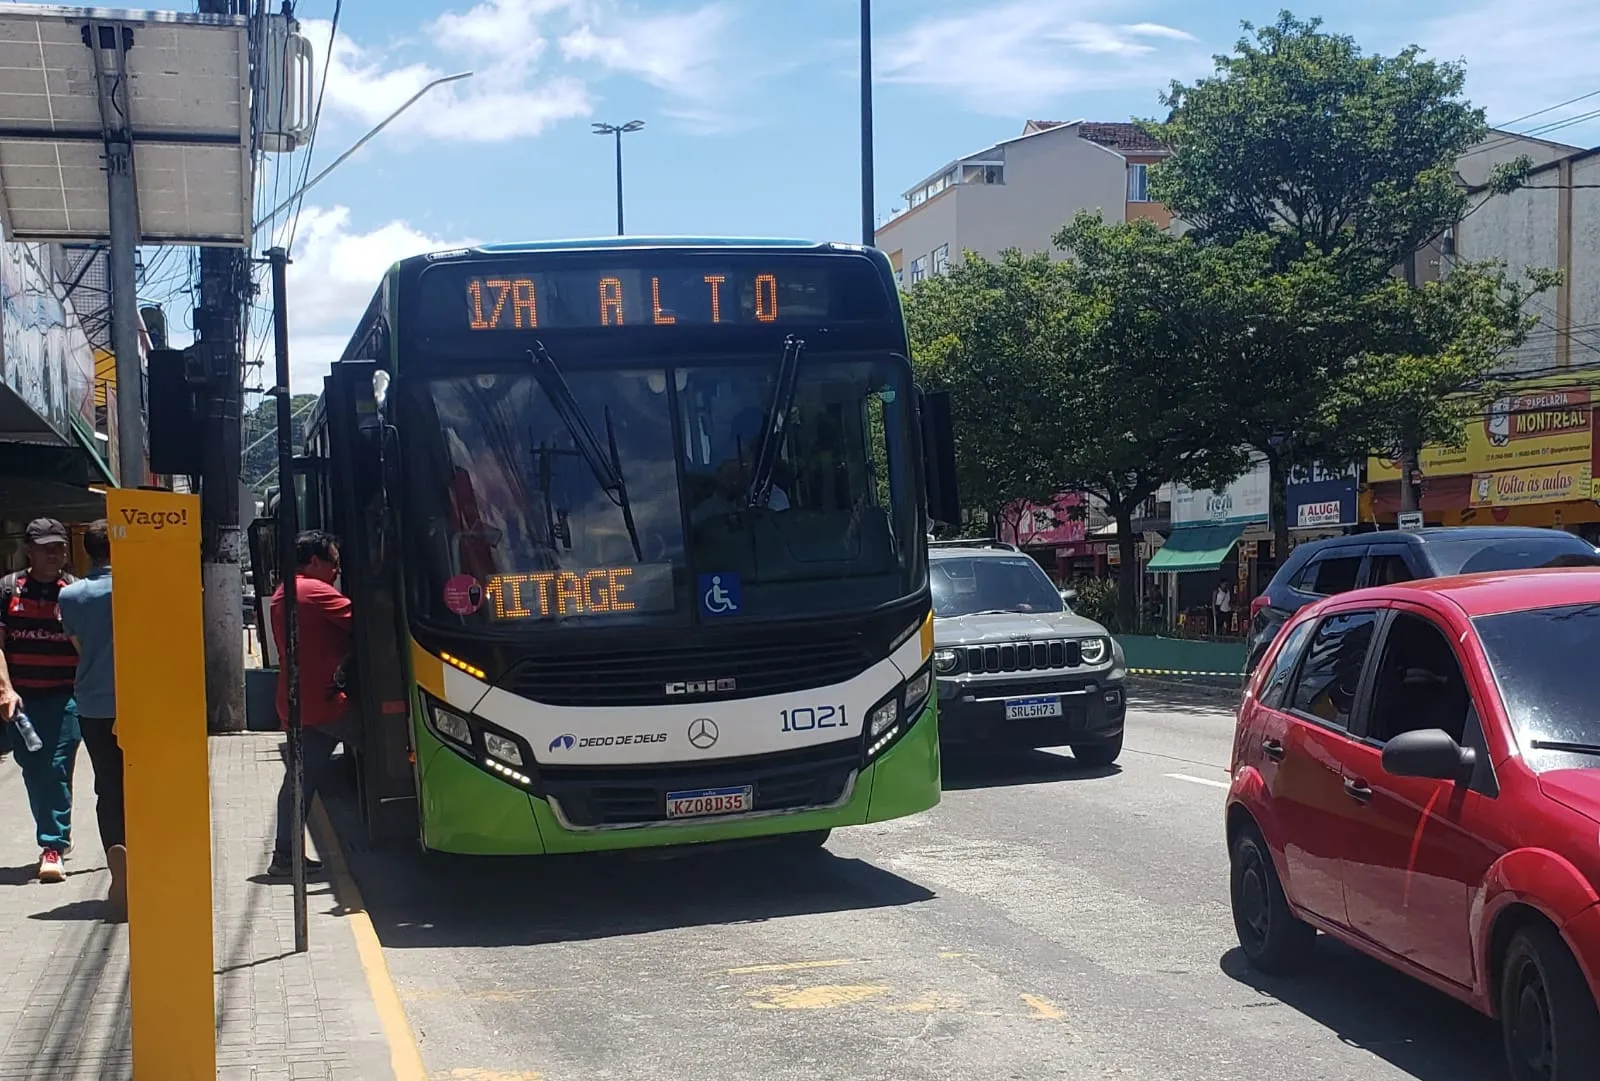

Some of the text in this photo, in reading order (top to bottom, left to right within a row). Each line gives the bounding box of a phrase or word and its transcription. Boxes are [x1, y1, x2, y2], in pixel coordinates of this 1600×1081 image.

[469, 274, 777, 329] 17A ALTO
[1526, 393, 1568, 408] PAPELARIA
[1516, 411, 1586, 433] MONTREAL
[1496, 474, 1525, 494] Volta
[1542, 470, 1573, 491] aulas
[1307, 502, 1339, 516] ALUGA
[120, 508, 188, 530] Vago!
[111, 525, 128, 540] 16
[780, 704, 849, 732] 1021
[1011, 703, 1055, 718] SRL5H73
[578, 732, 668, 748] DEDO DE DEUS
